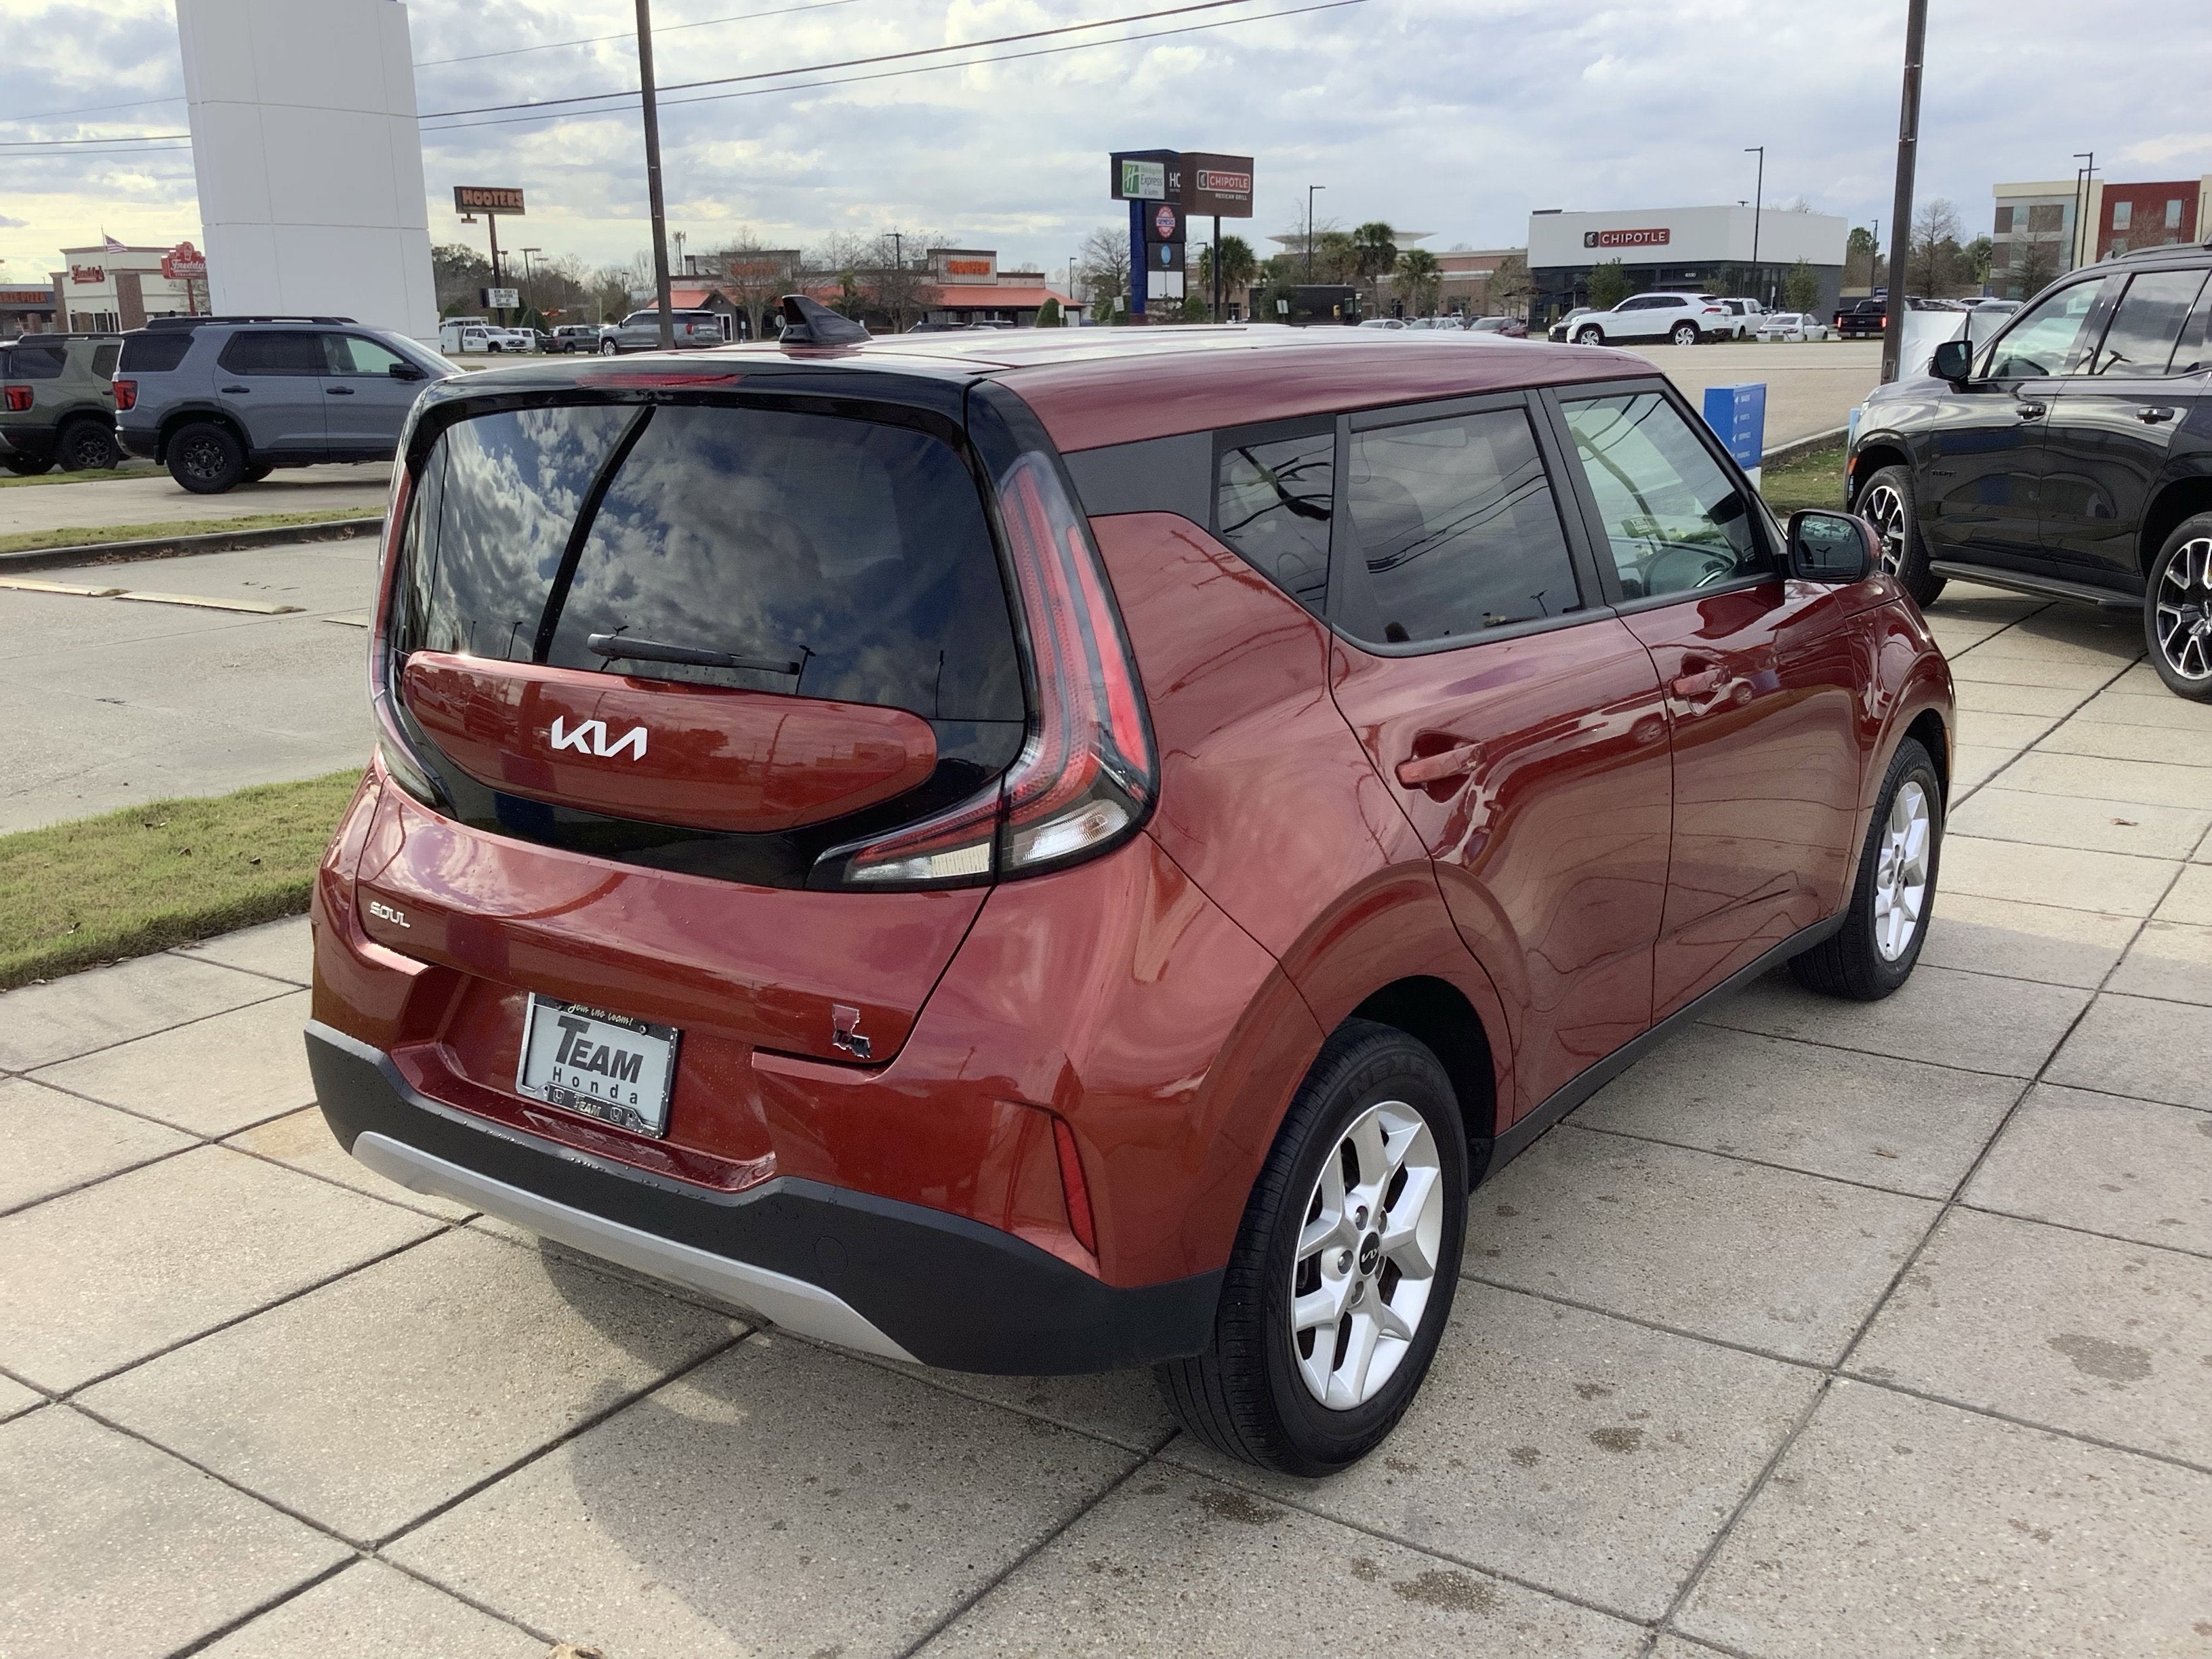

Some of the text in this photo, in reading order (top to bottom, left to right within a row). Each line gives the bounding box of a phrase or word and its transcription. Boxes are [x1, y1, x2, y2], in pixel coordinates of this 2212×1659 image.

[1141, 174, 1163, 187] Express
[1210, 176, 1248, 188] CHIPOTLE
[462, 189, 523, 207] HOOTERS
[1601, 231, 1666, 244] CHIPOTLE
[551, 715, 648, 761] KIA
[369, 901, 411, 928] SOUL
[552, 1067, 638, 1105] Honda
